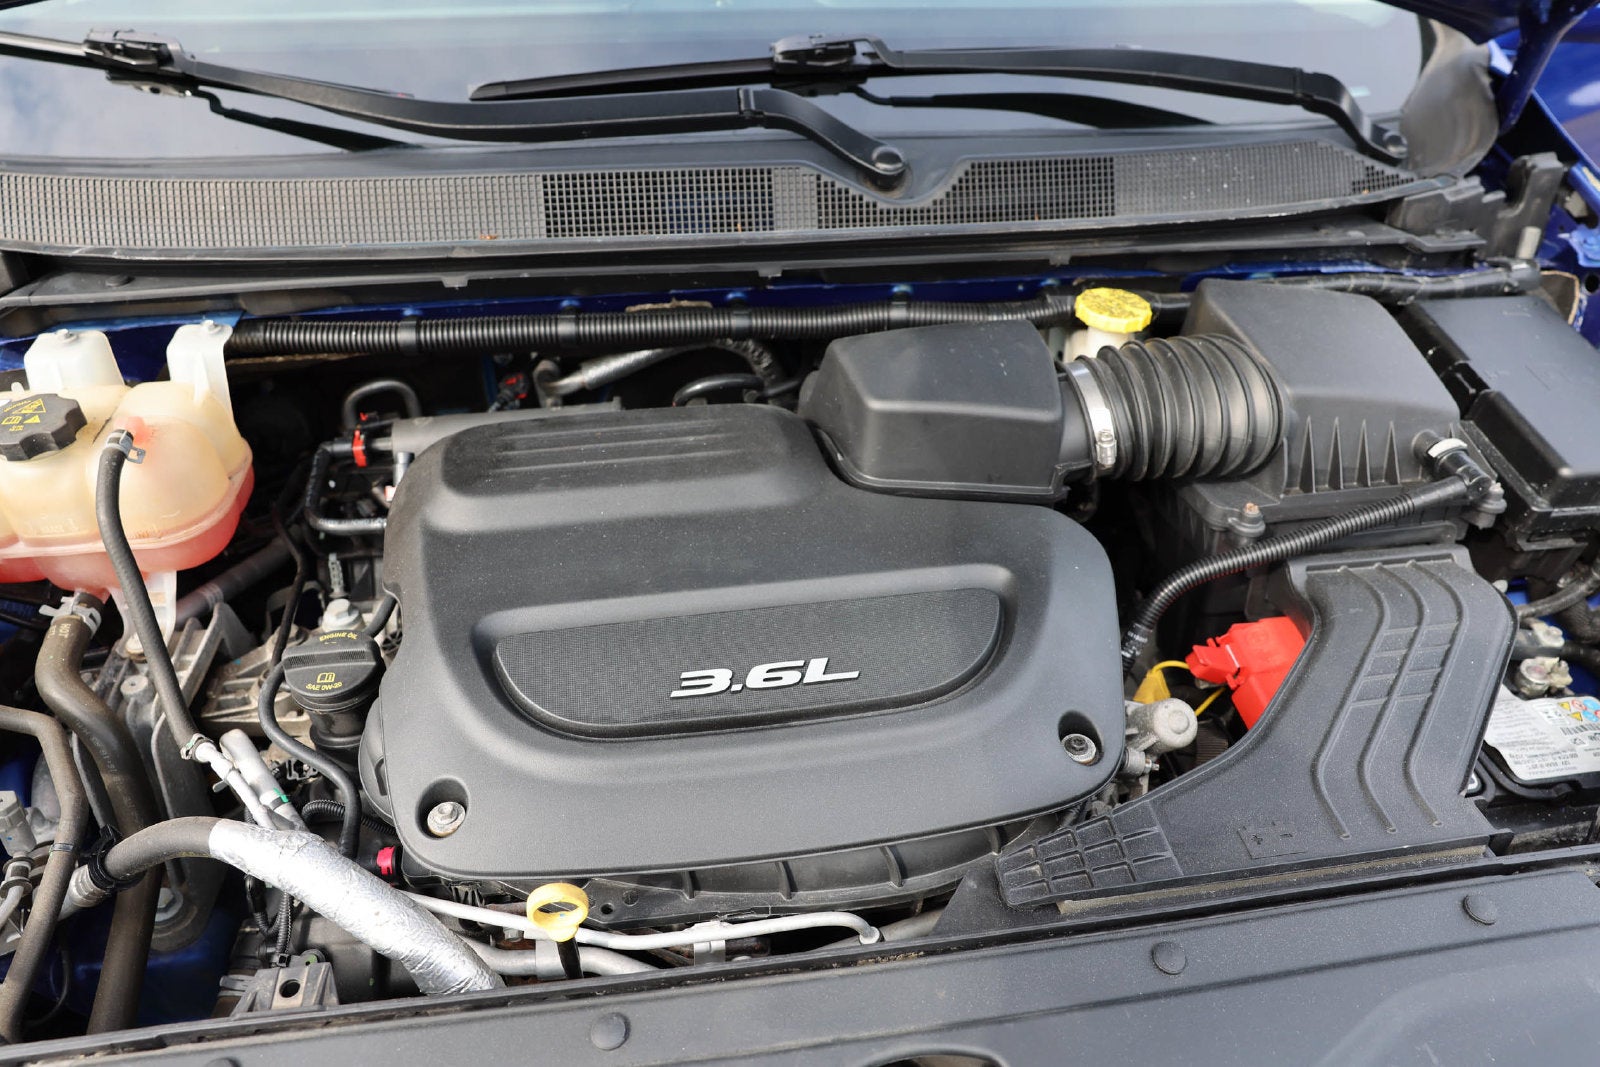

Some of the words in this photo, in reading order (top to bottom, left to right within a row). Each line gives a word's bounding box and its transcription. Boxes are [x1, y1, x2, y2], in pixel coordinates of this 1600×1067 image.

[319, 632, 347, 641] ENGINE
[347, 632, 358, 640] OIL
[670, 657, 860, 698] 3.6L
